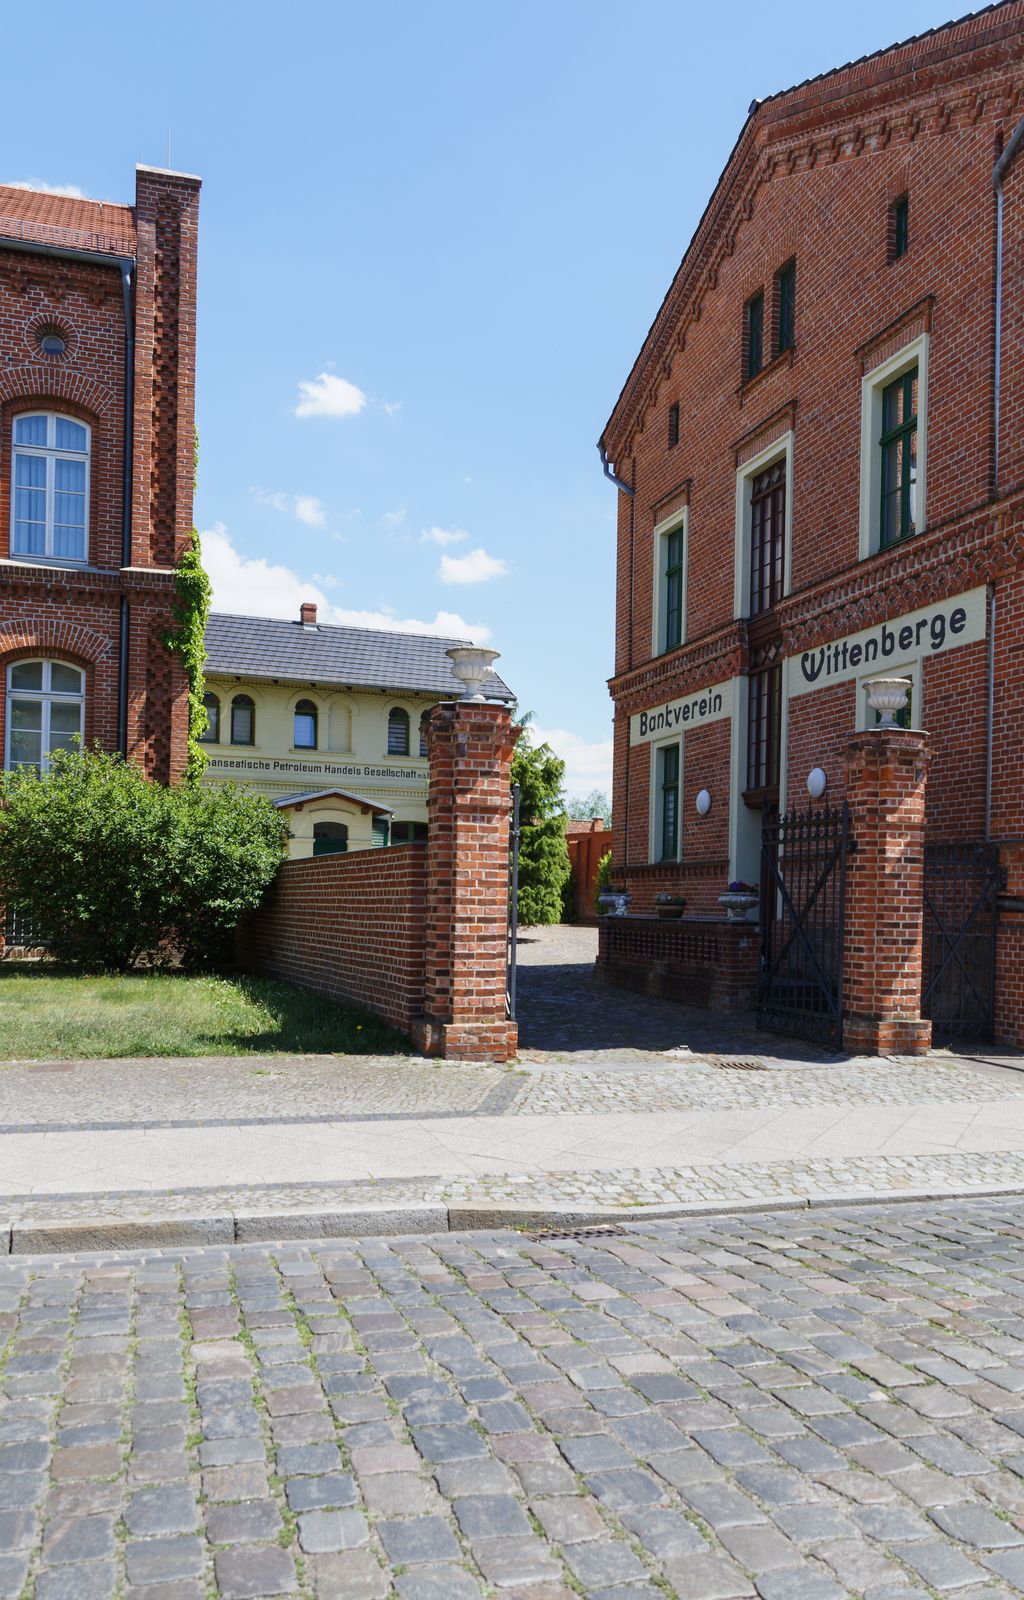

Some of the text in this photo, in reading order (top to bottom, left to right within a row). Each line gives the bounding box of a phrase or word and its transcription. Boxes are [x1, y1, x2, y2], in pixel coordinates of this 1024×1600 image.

[801, 608, 967, 682] Wittenberge
[640, 688, 722, 736] Bankverein
[273, 761, 322, 773] Petroleum
[324, 764, 361, 775] Handels
[364, 767, 417, 779] Gesellschaft
